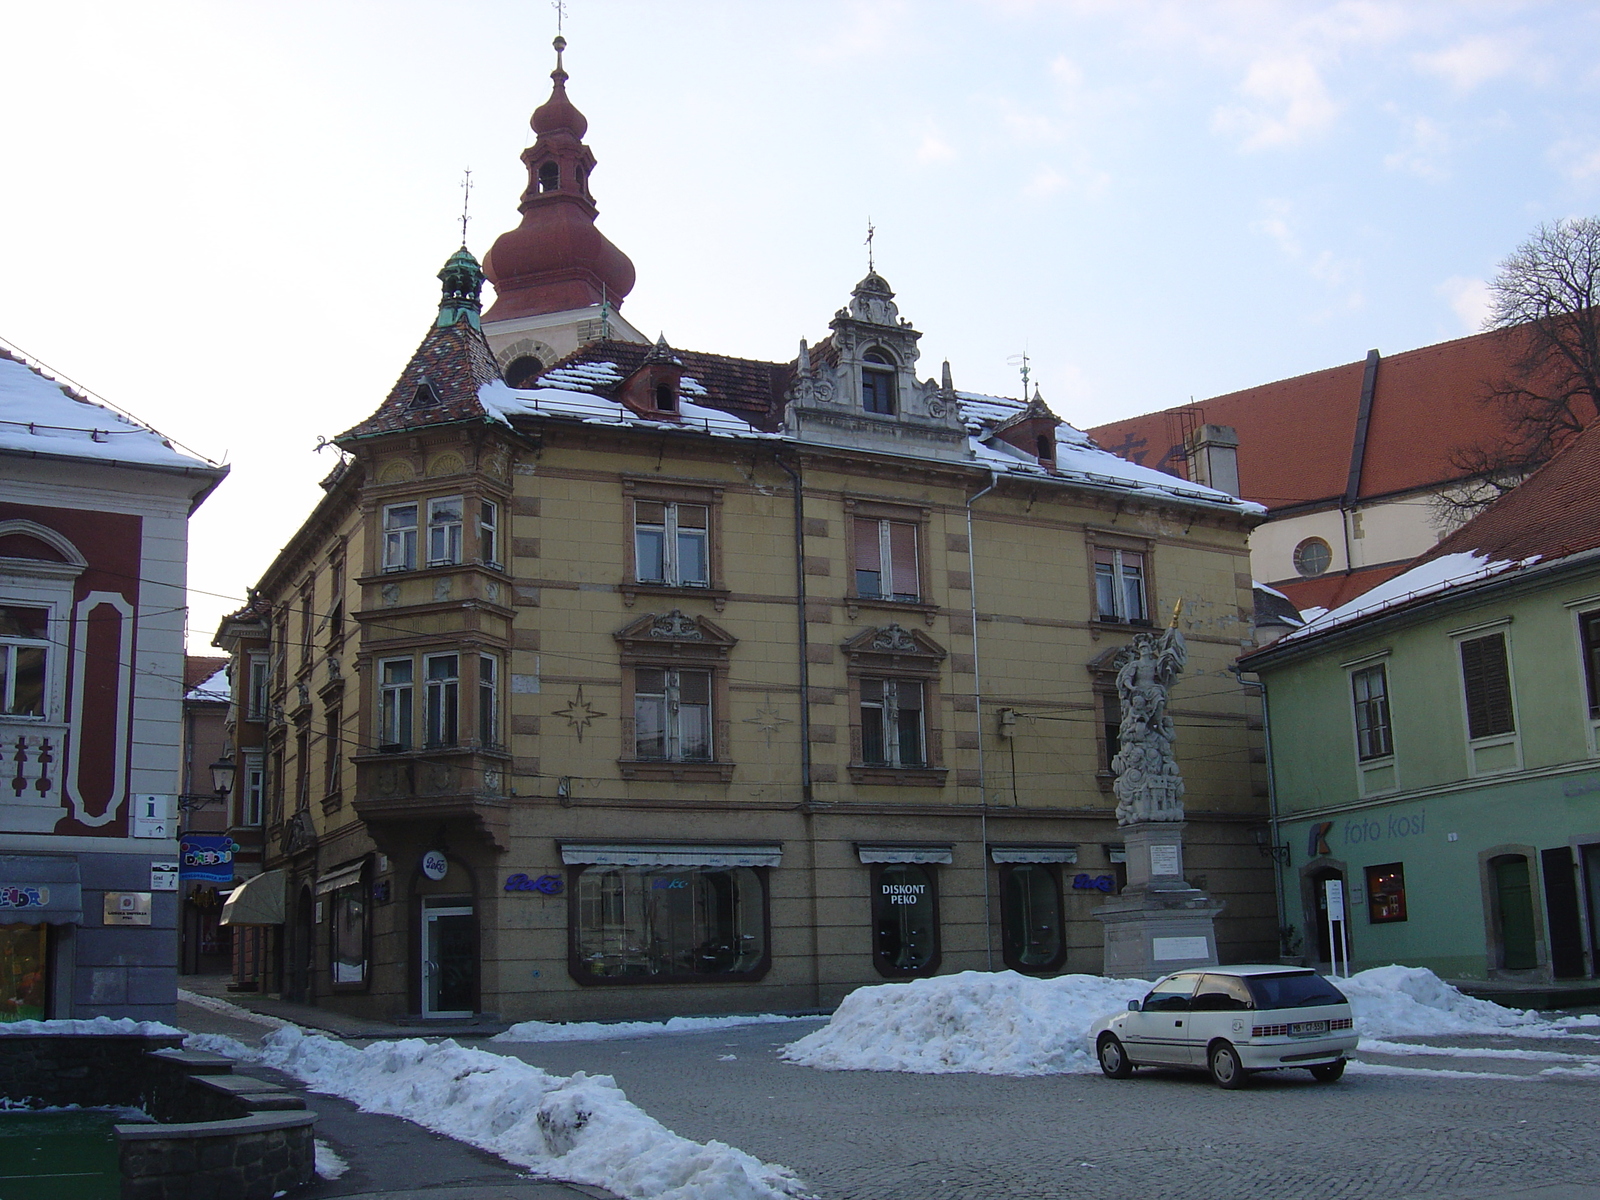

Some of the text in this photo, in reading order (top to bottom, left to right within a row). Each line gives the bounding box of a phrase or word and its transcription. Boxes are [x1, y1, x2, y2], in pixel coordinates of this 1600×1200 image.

[1344, 808, 1426, 844] foto kosi
[426, 856, 446, 873] Peko
[503, 873, 565, 895] Peko
[882, 885, 926, 895] DISKONT
[891, 895, 917, 905] PEKO
